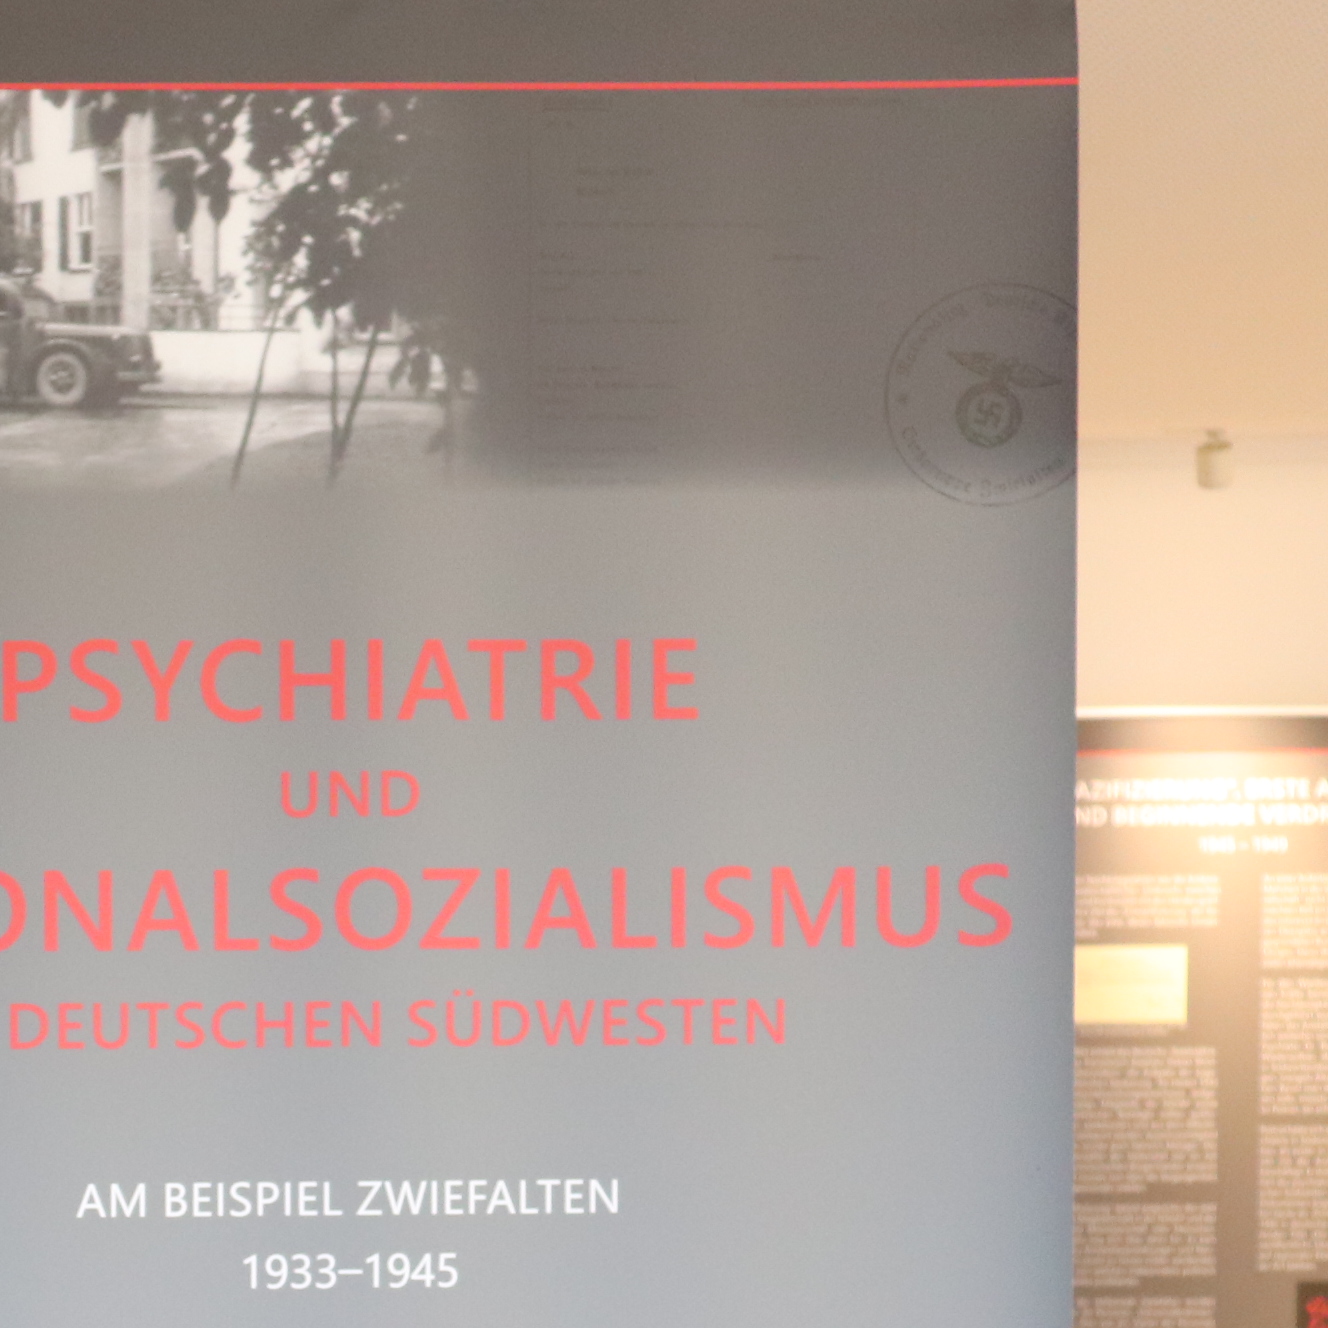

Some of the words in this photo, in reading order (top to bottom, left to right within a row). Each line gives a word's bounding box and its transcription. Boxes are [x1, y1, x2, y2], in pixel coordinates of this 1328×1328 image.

[0, 637, 701, 725] PSYCHIATRIE
[279, 769, 421, 820] UND
[8, 999, 383, 1051] DEUTSCHEN
[407, 988, 787, 1049] SÜDWESTEN
[75, 1182, 148, 1219] AM
[163, 1180, 345, 1219] BEISPIEL
[355, 1177, 620, 1217] ZWIEFALTEN
[242, 1251, 459, 1291] 1933–1945
